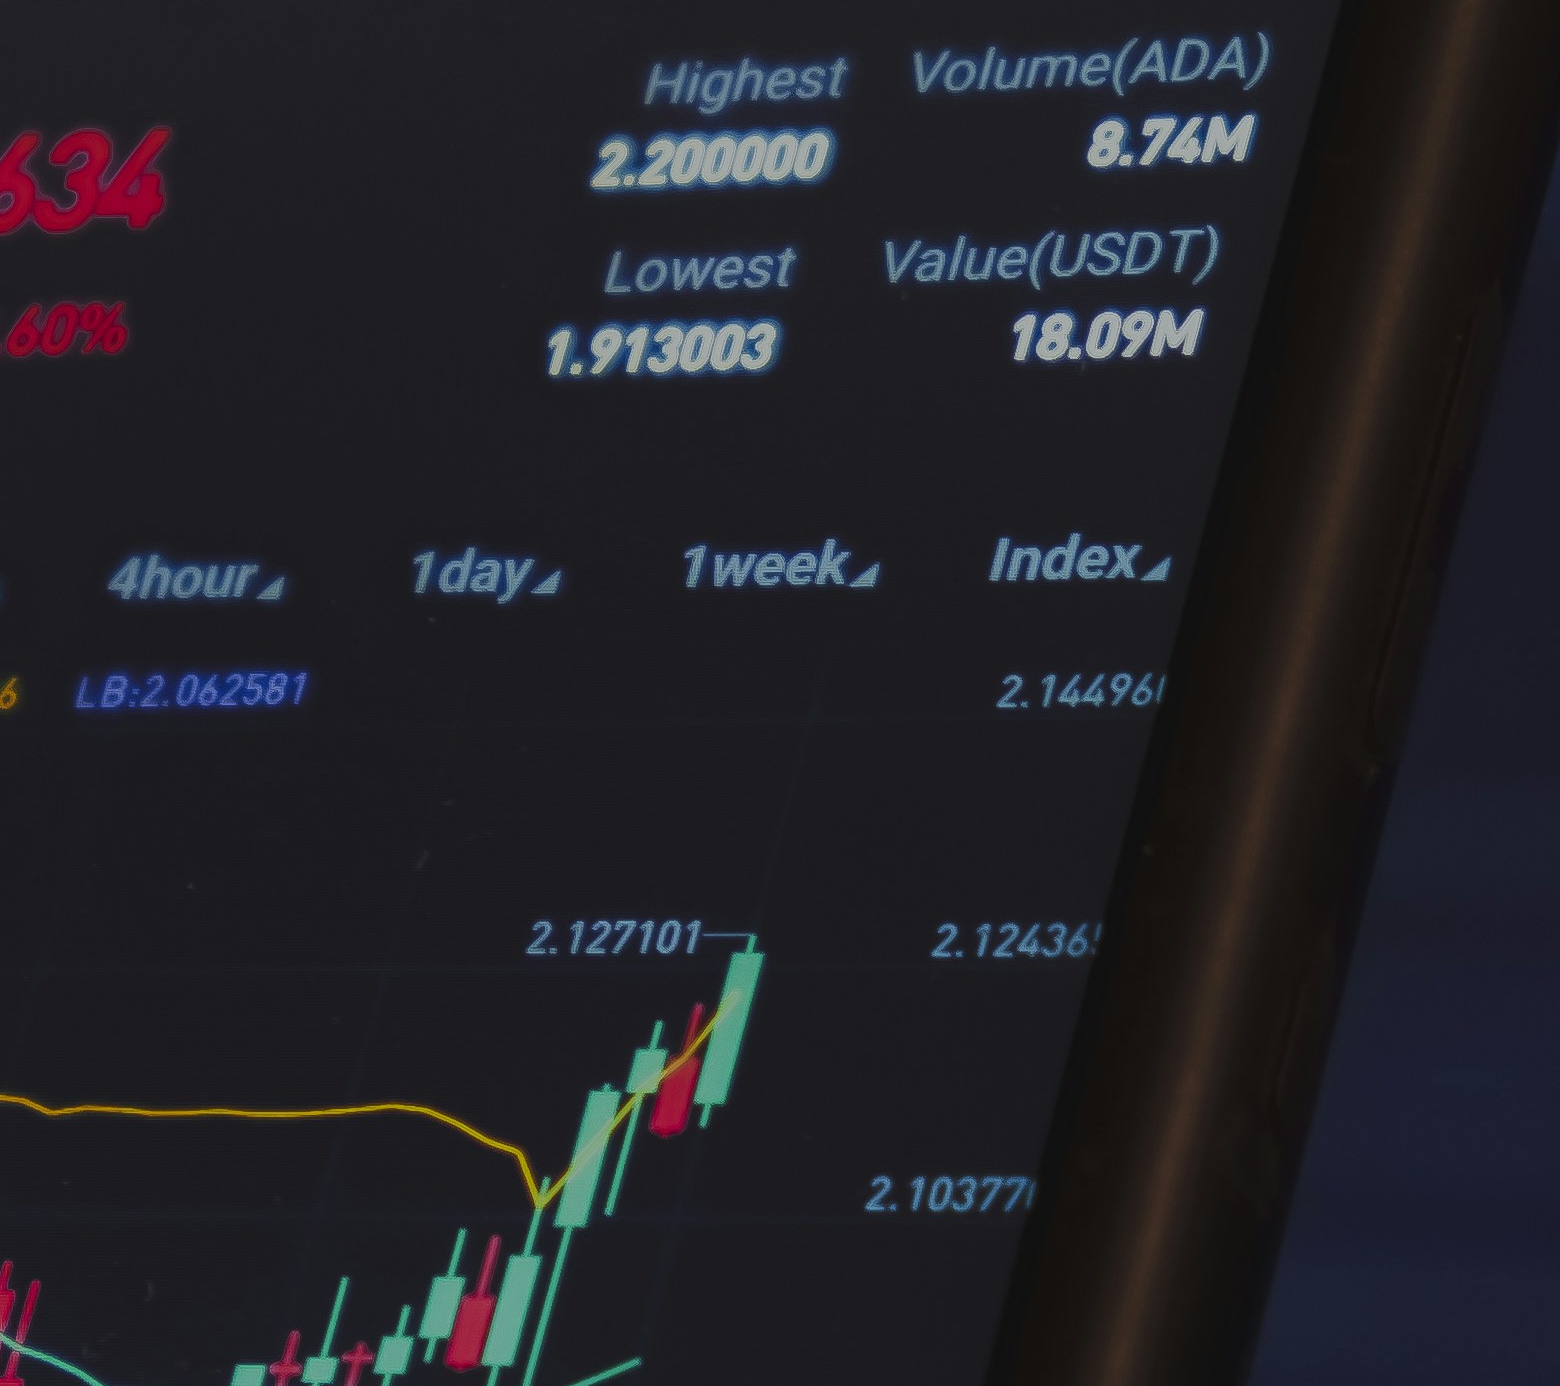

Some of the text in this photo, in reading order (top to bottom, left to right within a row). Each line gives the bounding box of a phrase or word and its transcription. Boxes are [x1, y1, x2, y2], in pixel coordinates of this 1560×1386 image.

[643, 55, 850, 116] Highest
[912, 30, 1272, 97] Volume(ADA)
[588, 129, 836, 191] 2.200000
[1085, 111, 1259, 170] 8.74M
[603, 245, 799, 295] Lowest
[883, 223, 1221, 291] Value(USDT)
[546, 318, 782, 377] 1.913003
[1011, 305, 1208, 364] 18.09M
[106, 553, 260, 602] 4hour
[412, 545, 534, 605] 1day
[682, 538, 852, 589] 1week
[987, 532, 1143, 583] Index
[74, 669, 309, 711] LB:2.062581
[524, 918, 703, 956] 2.127101
